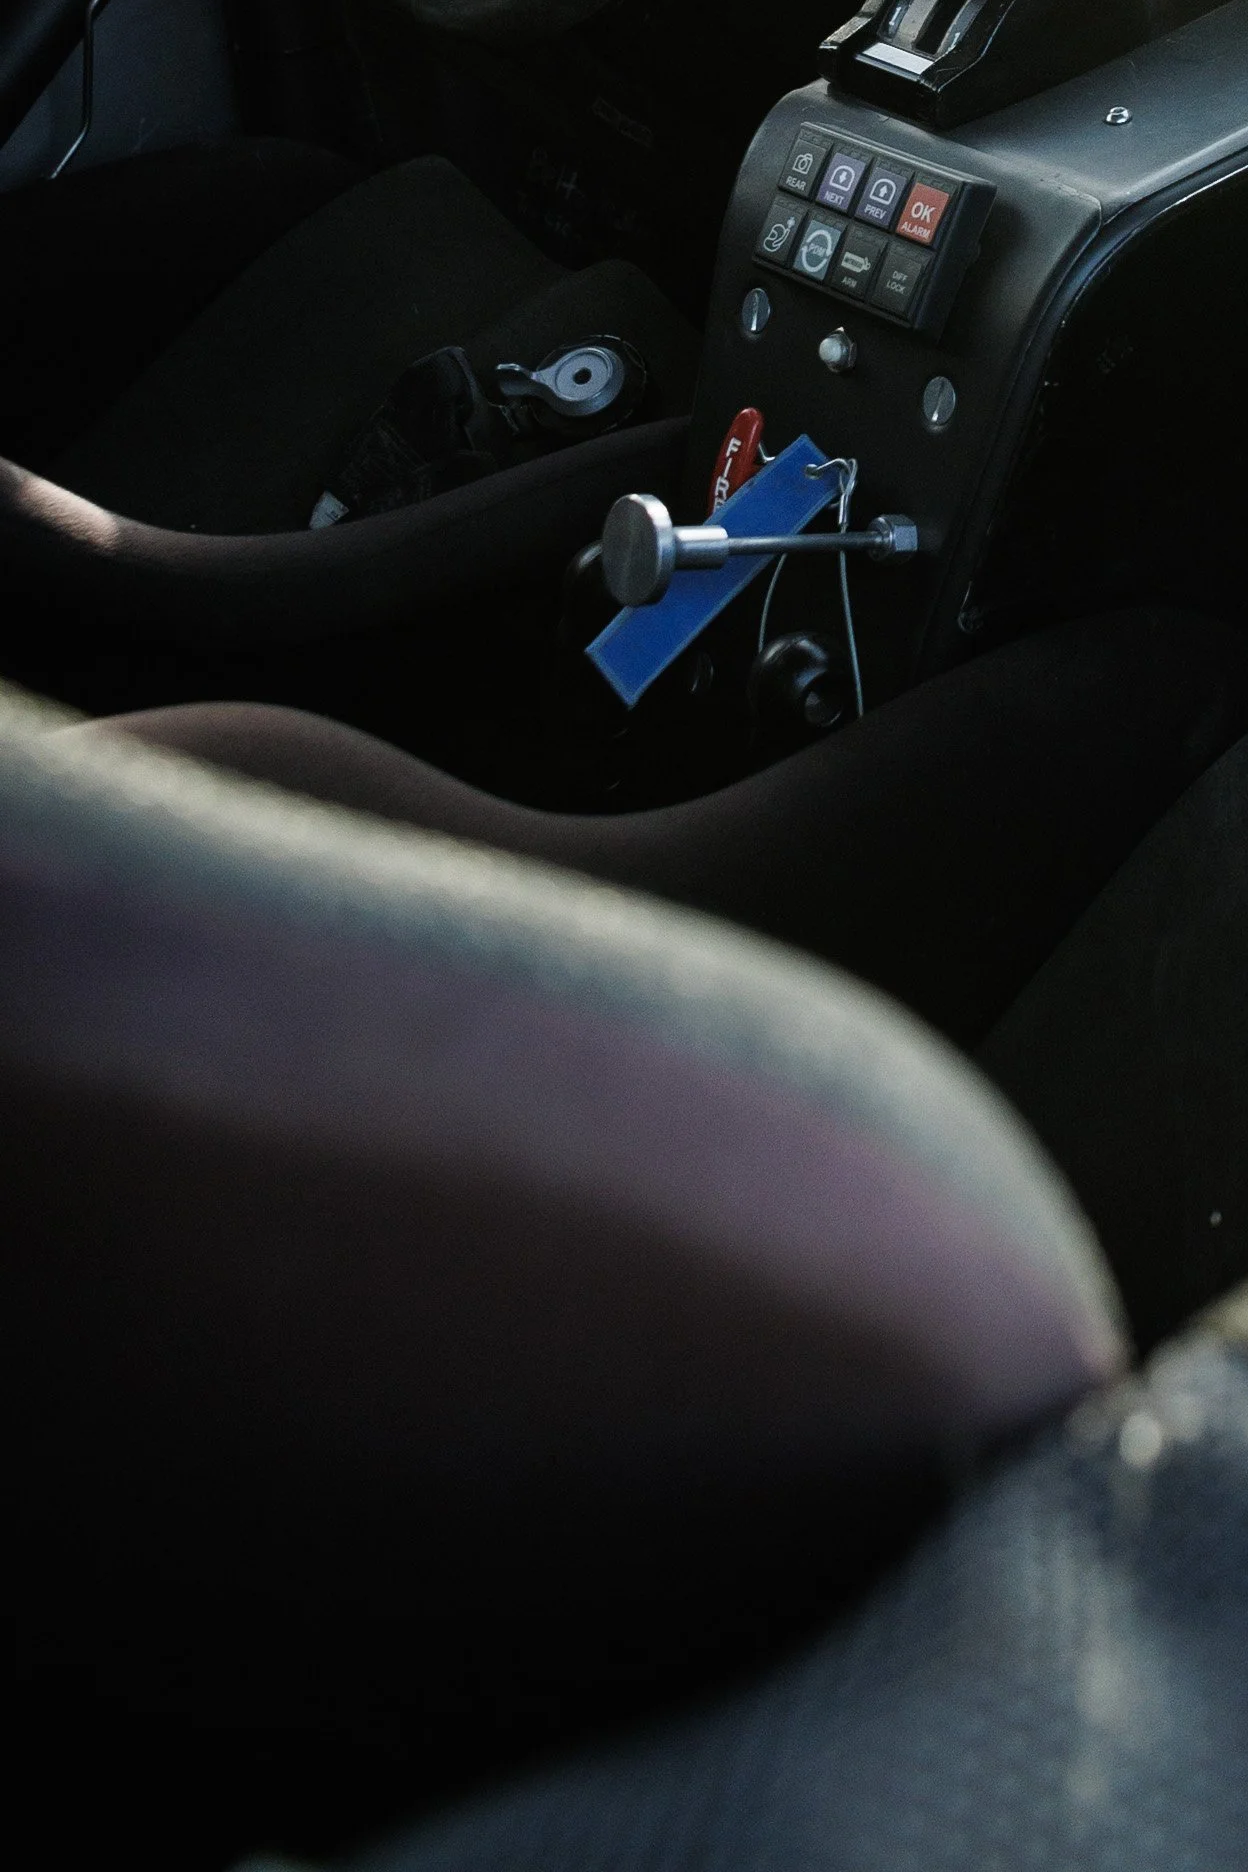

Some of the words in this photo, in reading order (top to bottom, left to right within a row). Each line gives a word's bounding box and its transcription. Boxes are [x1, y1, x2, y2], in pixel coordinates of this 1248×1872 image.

[785, 175, 806, 191] REAR
[824, 190, 844, 207] NEXT
[864, 205, 887, 220] PREV
[911, 201, 935, 223] OK
[901, 221, 931, 240] ALARM
[892, 270, 909, 282] DIFF
[887, 279, 906, 295] LOCK
